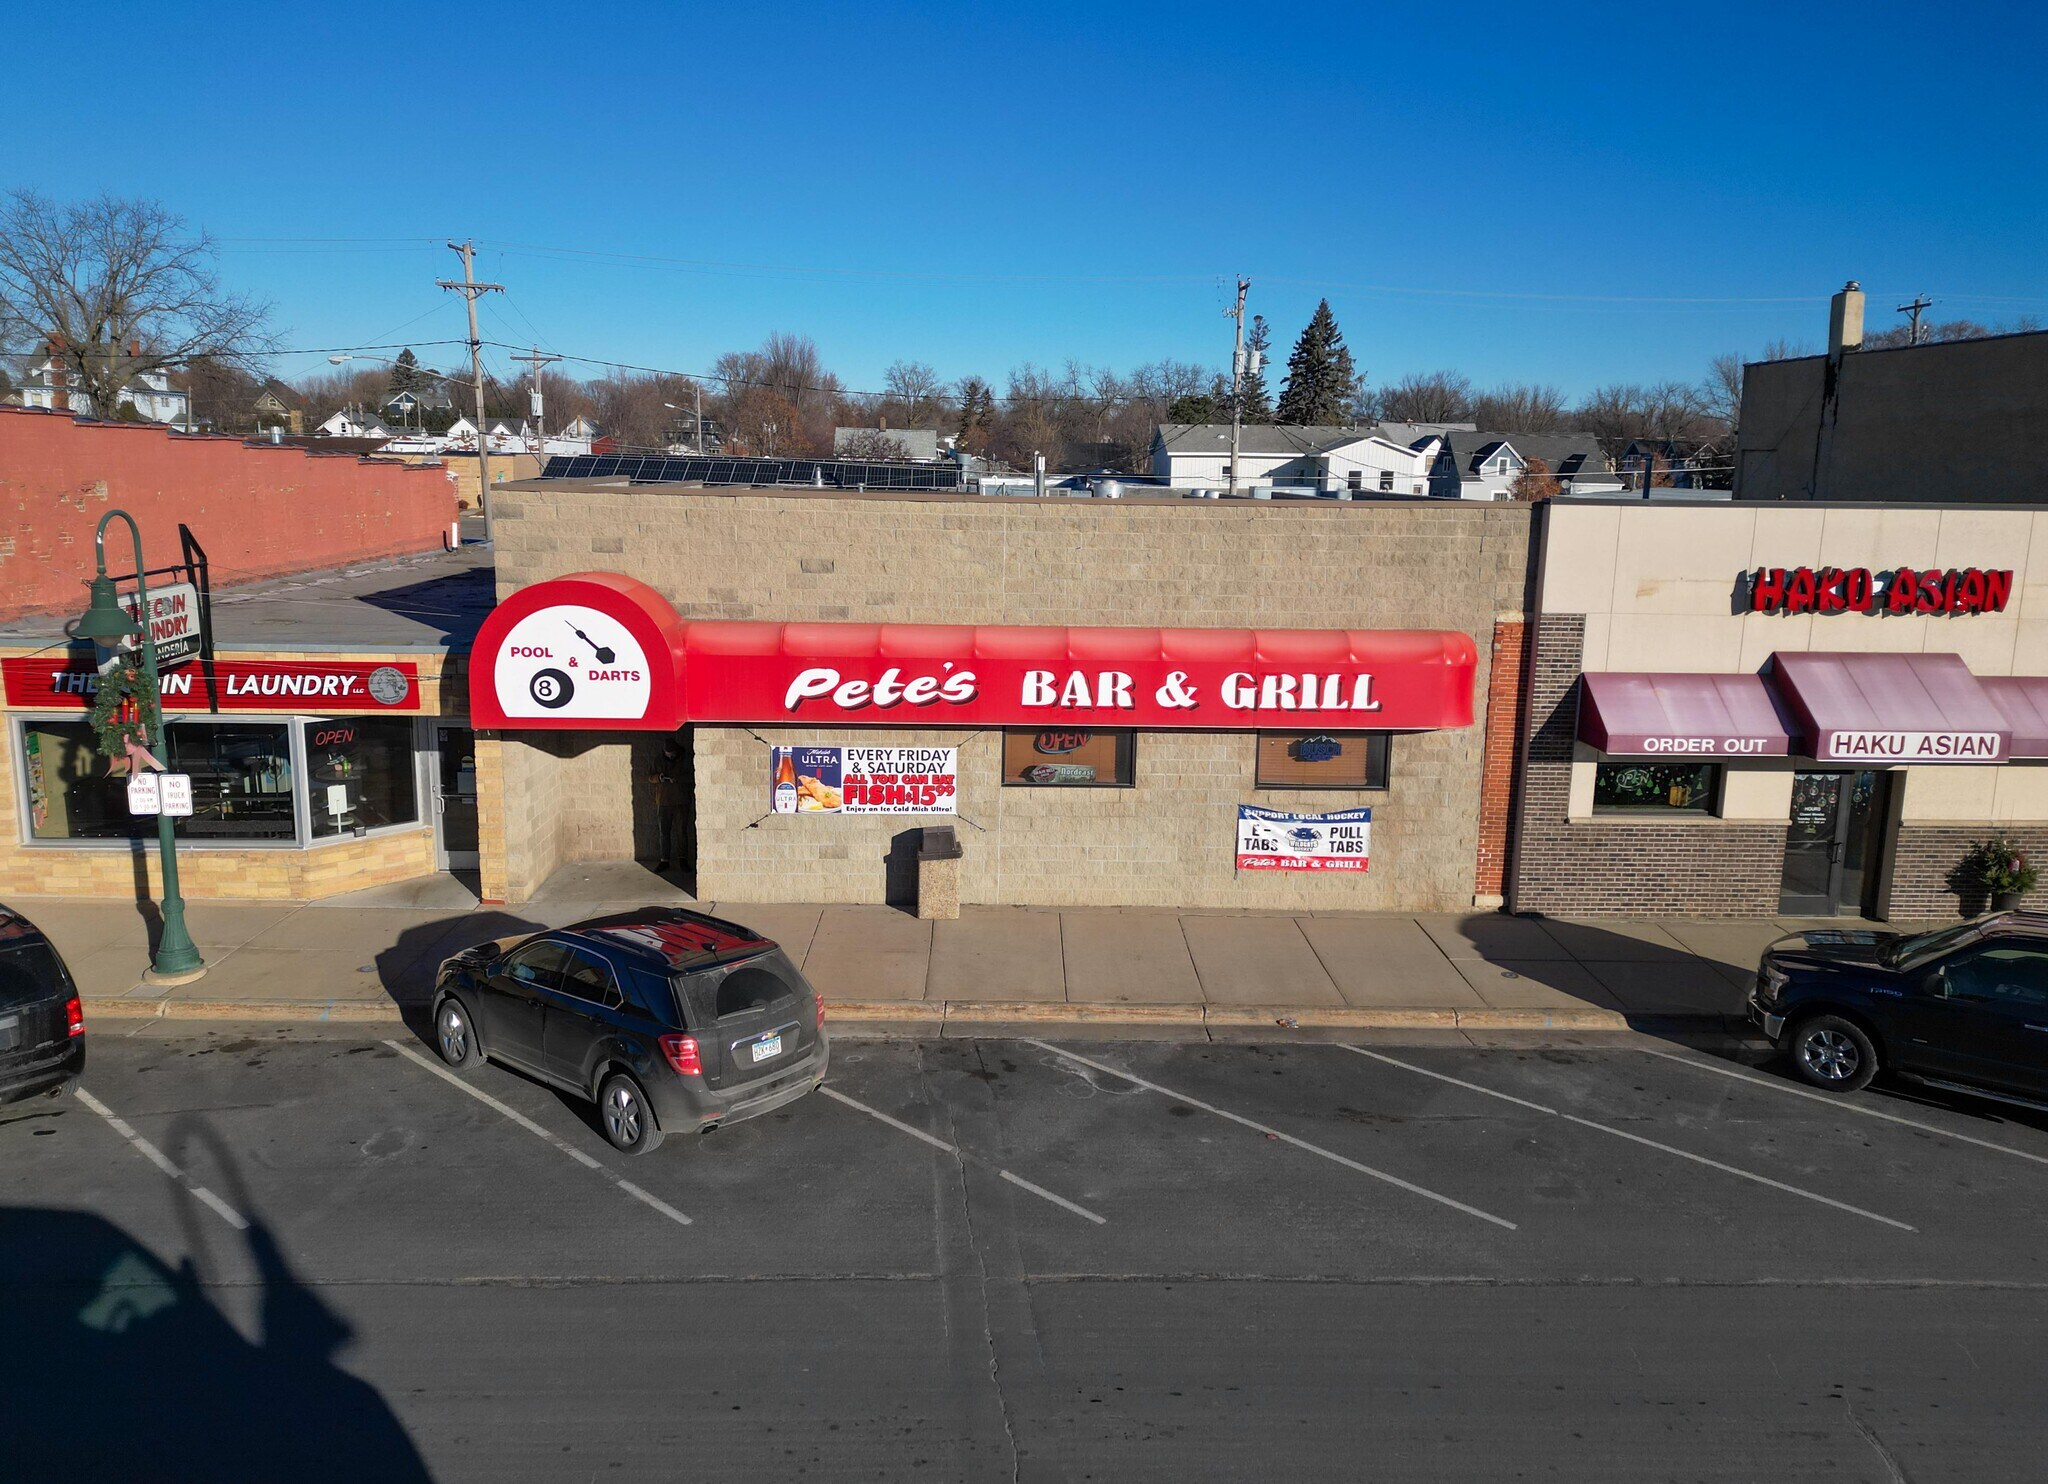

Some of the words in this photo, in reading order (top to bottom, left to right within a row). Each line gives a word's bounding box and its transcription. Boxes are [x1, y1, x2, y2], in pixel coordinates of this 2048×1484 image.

[510, 646, 553, 658] POOL
[568, 656, 579, 667] &
[589, 670, 640, 682] DARTS
[226, 674, 358, 696] LAUNDRY
[538, 680, 552, 697] 8
[785, 661, 979, 711] Pete's
[1021, 670, 1135, 709] BAR
[1155, 670, 1199, 710] &
[1220, 671, 1380, 711] GRILL
[315, 729, 354, 746] OPEN
[1040, 732, 1088, 751] OPEN
[1643, 738, 1715, 753] ORDER
[1723, 738, 1767, 754] OUT
[1834, 734, 1905, 755] HAKU
[1917, 734, 1995, 756] ASIAN
[801, 755, 839, 764] ULTRA
[848, 749, 893, 761] EVERY
[898, 749, 951, 761] FRIDAY
[852, 761, 862, 774] &
[867, 762, 946, 774] SATURDAY
[843, 774, 868, 785] ALL
[870, 774, 899, 785] YOU
[901, 774, 929, 785] CAN
[931, 774, 955, 785] EAT
[131, 787, 156, 795] PARKING
[843, 785, 905, 805] FISH
[165, 802, 189, 810] PARKING
[1245, 808, 1289, 820] SUPPORT
[1327, 811, 1366, 820] HOCKEY
[1330, 826, 1364, 839] PULL
[1244, 837, 1279, 852] TABS
[1329, 840, 1363, 853] TABS
[1280, 858, 1307, 868] BAR
[1310, 859, 1322, 868] &
[1326, 860, 1363, 869] GRILL
